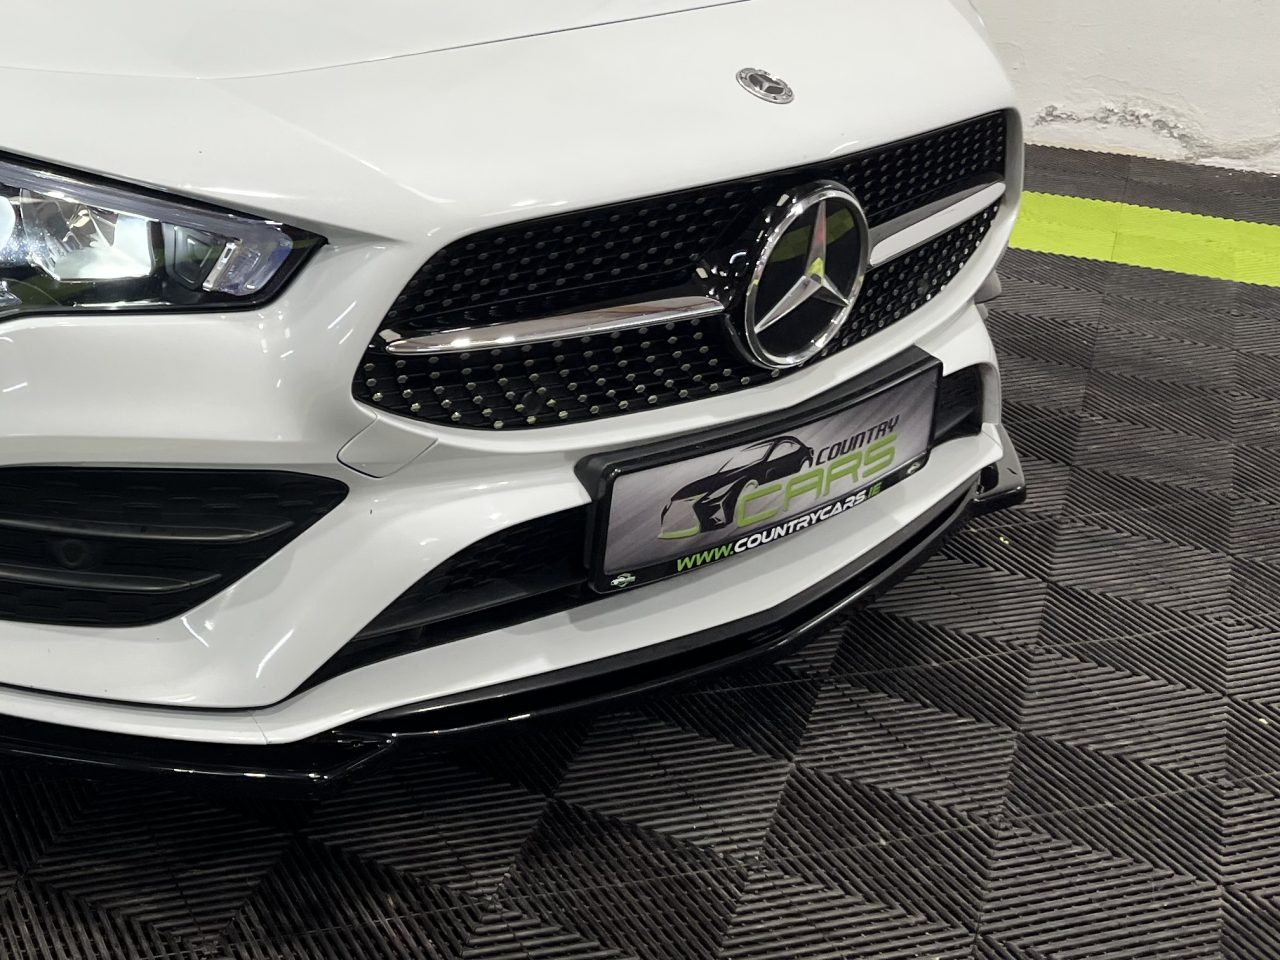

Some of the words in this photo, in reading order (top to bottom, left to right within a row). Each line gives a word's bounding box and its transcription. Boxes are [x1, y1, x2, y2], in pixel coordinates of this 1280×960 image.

[735, 433, 897, 528] CARS
[815, 414, 900, 466] COUNTRY
[676, 481, 883, 572] WWW.COUNTRYCARS.IE
